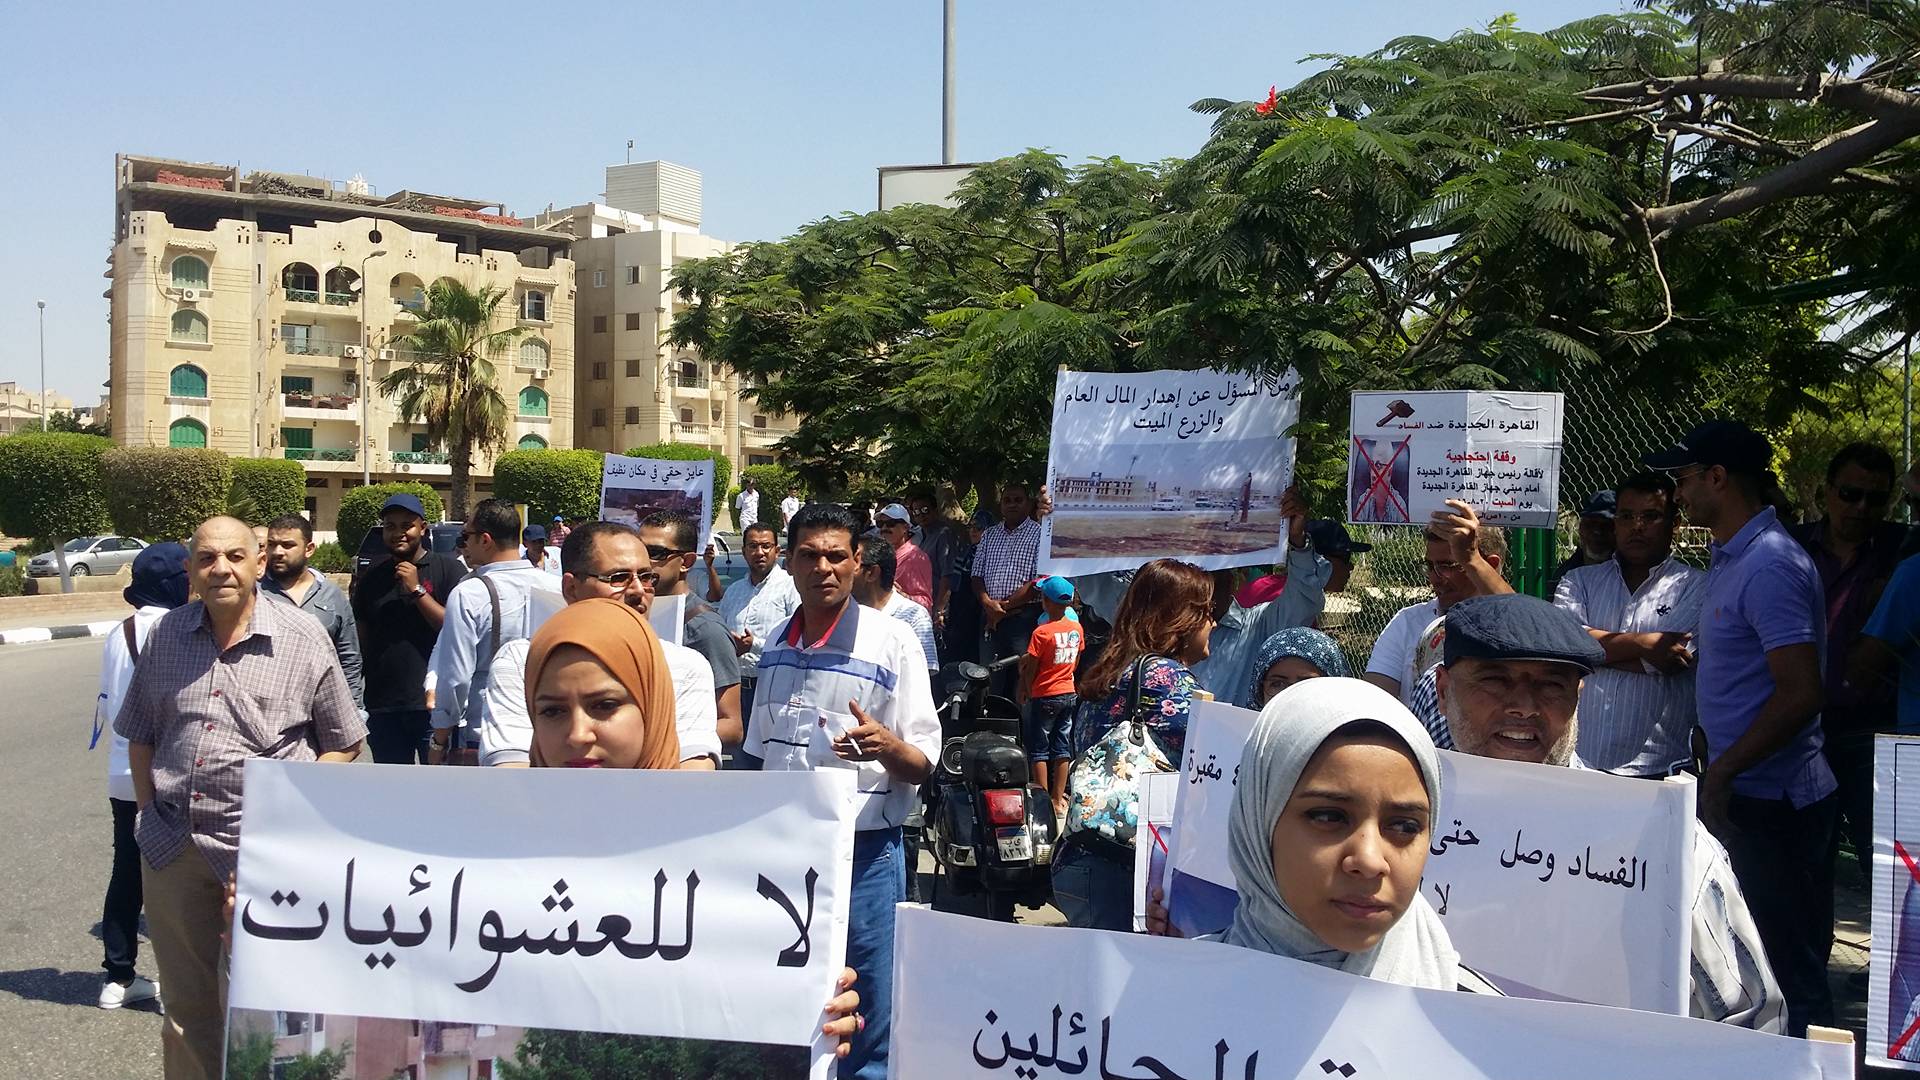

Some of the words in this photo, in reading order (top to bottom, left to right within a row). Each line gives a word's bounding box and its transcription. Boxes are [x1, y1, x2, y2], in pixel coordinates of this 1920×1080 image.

[1064, 384, 1098, 413] العام
[1105, 384, 1136, 404] المال
[1141, 388, 1181, 410] إهدار
[1188, 389, 1210, 407] عن
[1133, 413, 1171, 435] الميت
[1177, 410, 1224, 439] والزرع
[1397, 421, 1424, 430] الفساد
[1426, 421, 1444, 429] ضد
[1448, 419, 1495, 431] الجديدة
[1498, 420, 1539, 433] القاهرة
[1446, 449, 1490, 464] إحتجاجية
[1493, 450, 1517, 465] وقفة
[606, 463, 626, 477] نظيف
[628, 464, 647, 478] مكان
[649, 464, 658, 482] في
[661, 465, 682, 485] حقي
[685, 465, 704, 481] عايز
[1416, 467, 1443, 478] الجديدة
[1445, 467, 1473, 478] القاهرة
[1475, 468, 1496, 479] جهاز
[1497, 469, 1521, 480] رئيس
[1422, 481, 1449, 492] الجديدة
[1450, 482, 1478, 493] القاهرة
[1480, 483, 1501, 494] جهاز
[1524, 484, 1540, 496] أمام
[1491, 497, 1516, 508] السبت
[1518, 499, 1533, 509] يوم
[1188, 748, 1223, 784] مقبرة
[1429, 819, 1481, 856] حتى
[1500, 828, 1555, 882] وصل
[1567, 845, 1648, 891] الفساد
[1434, 882, 1451, 916] لا
[756, 866, 820, 968] لا
[241, 858, 701, 993] للعشوائيات
